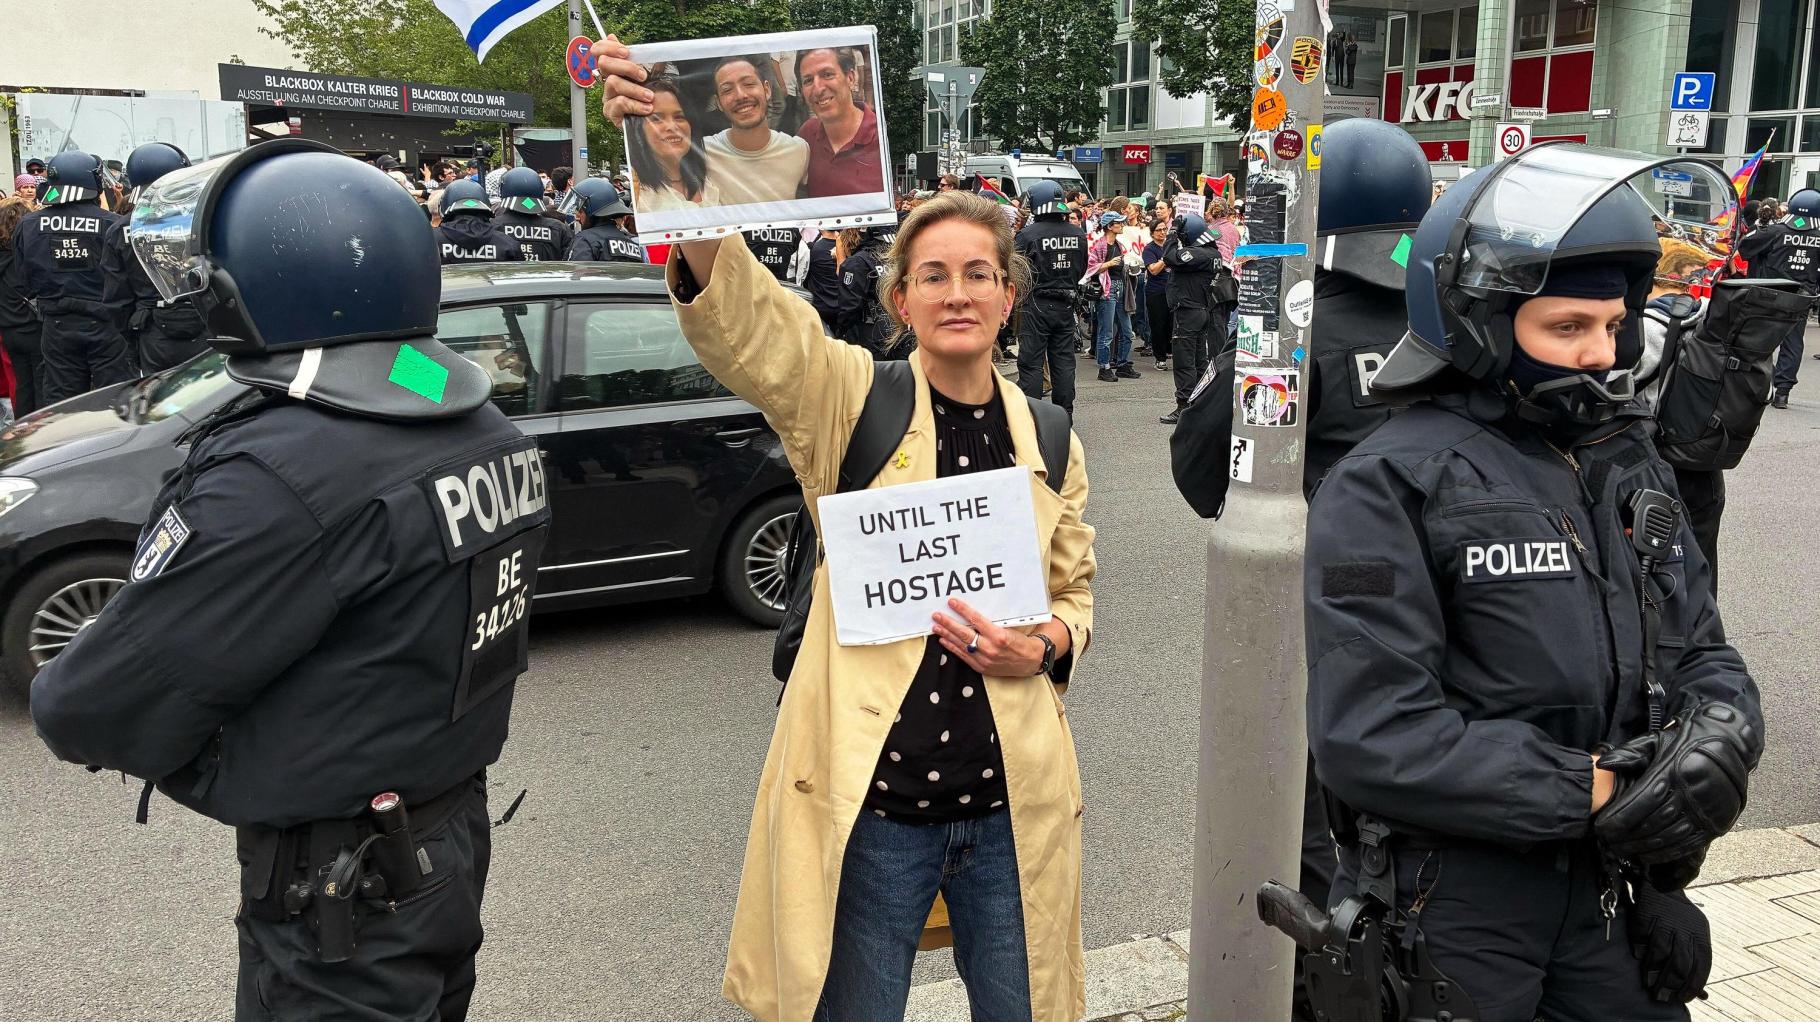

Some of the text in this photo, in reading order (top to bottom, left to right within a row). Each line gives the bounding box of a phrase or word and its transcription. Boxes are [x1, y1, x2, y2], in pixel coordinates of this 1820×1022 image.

[265, 75, 398, 98] BLACKBOX KALTER KRIEG
[1677, 77, 1701, 105] P
[237, 89, 400, 110] AUSSTELLUNG AM CHECKPOINT CHARLIE
[411, 88, 505, 106] BLACKBOX COLD WAR
[412, 102, 526, 119] EXHIBITION AT CHECKPOINT CHARLIE
[1505, 134, 1520, 147] 30
[1125, 150, 1148, 159] KFC
[39, 215, 100, 233] POLIZEI
[504, 225, 552, 240] POLIZEI
[751, 229, 793, 243] POLIZEI
[62, 238, 78, 248] BE
[520, 243, 533, 253] BE
[1042, 236, 1079, 250] POLIZEI
[1783, 234, 1820, 248] POLIZE
[54, 248, 89, 259] 34324
[442, 243, 497, 259] POLIZEI
[523, 253, 539, 261] 321
[767, 247, 778, 255] BE
[1057, 253, 1066, 261] BE
[1796, 249, 1807, 257] BE
[759, 255, 783, 264] 34314
[1787, 256, 1811, 264] 34300
[434, 447, 546, 548] POLIZEI
[859, 496, 991, 536] UNTIL THE
[162, 510, 186, 544] POLIZEI
[898, 534, 961, 564] LAST
[1466, 541, 1571, 577] POLIZEI
[497, 549, 522, 597] BE
[863, 562, 1006, 609] HOSTAGE
